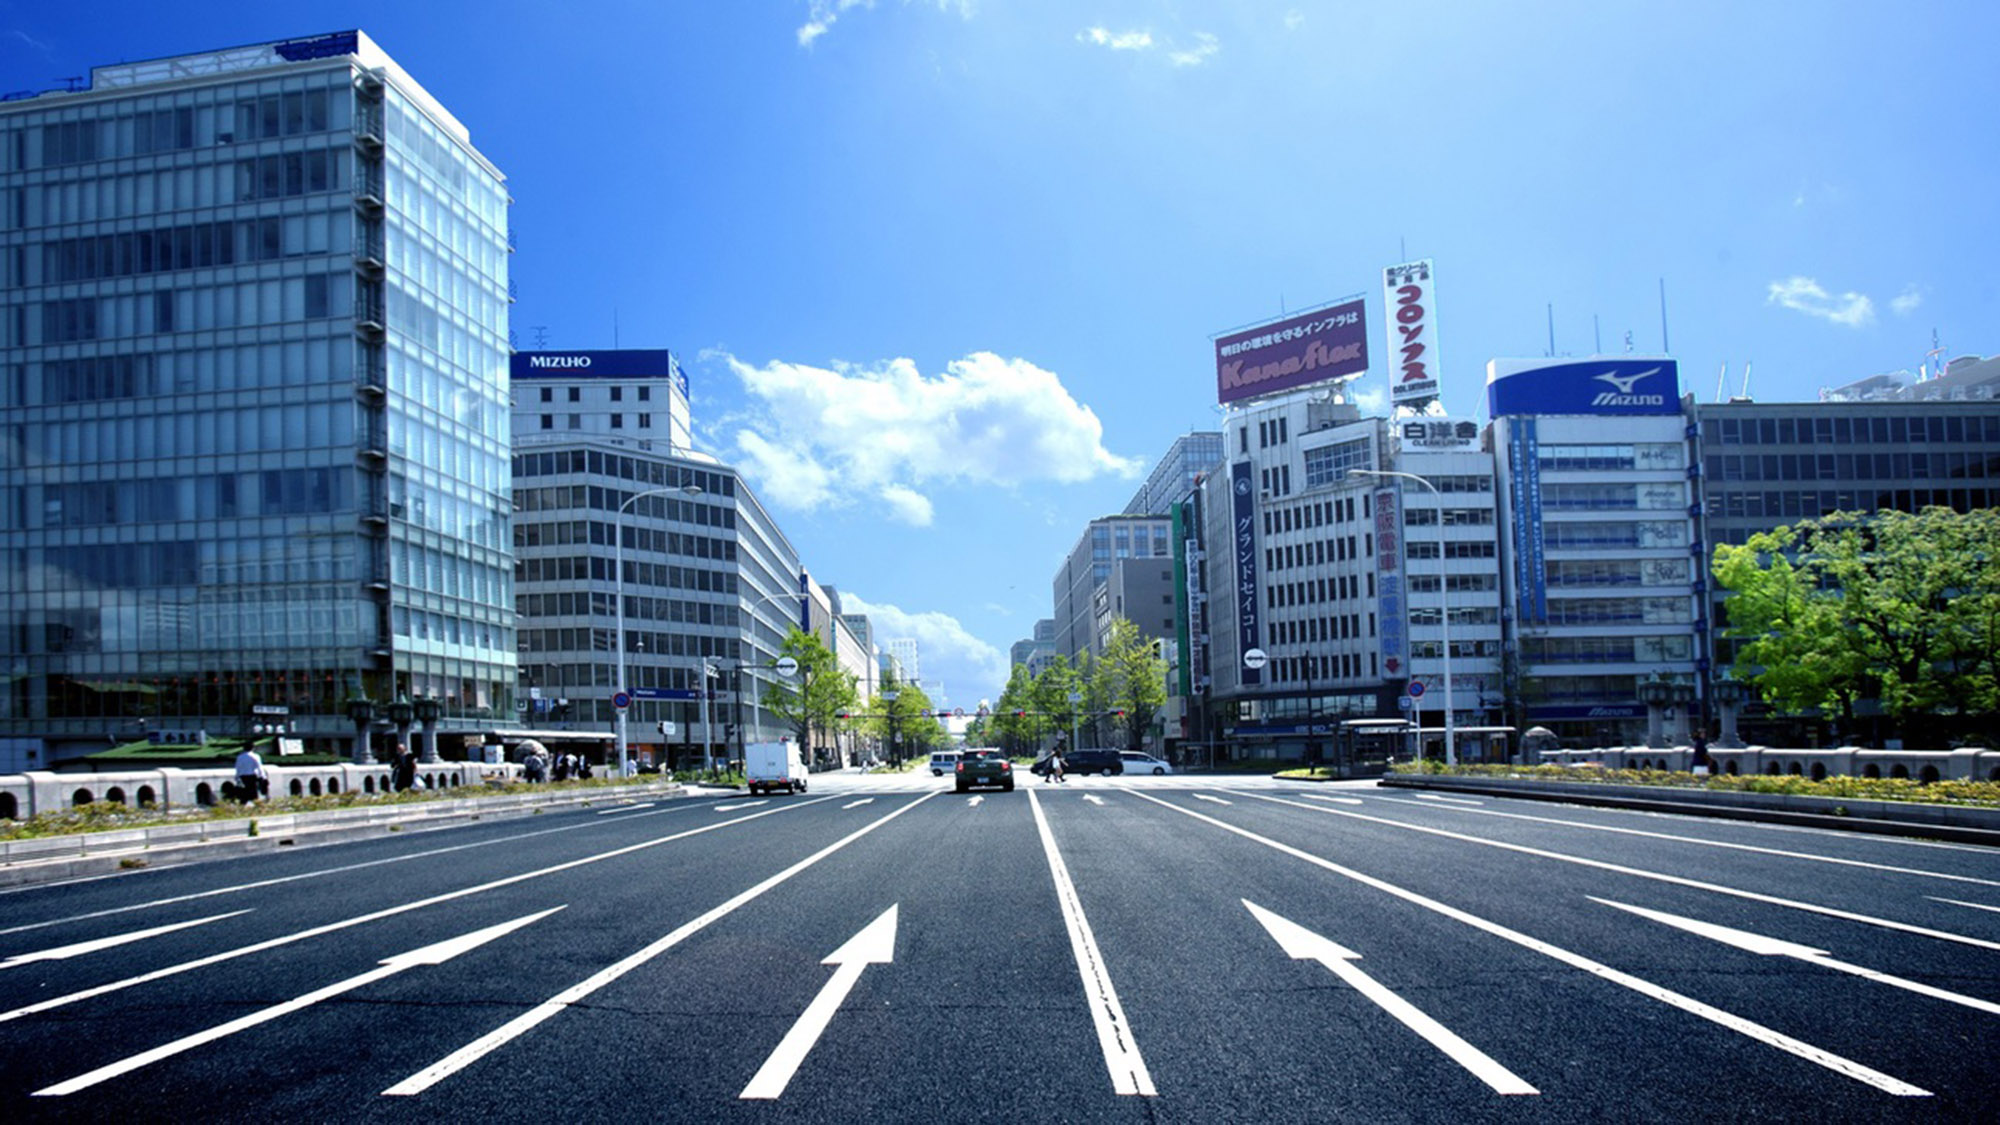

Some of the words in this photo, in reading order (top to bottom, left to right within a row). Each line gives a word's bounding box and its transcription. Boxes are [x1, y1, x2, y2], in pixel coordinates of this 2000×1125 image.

[530, 355, 591, 368] MIZUHO
[1238, 515, 1255, 643] グランドセイコー
